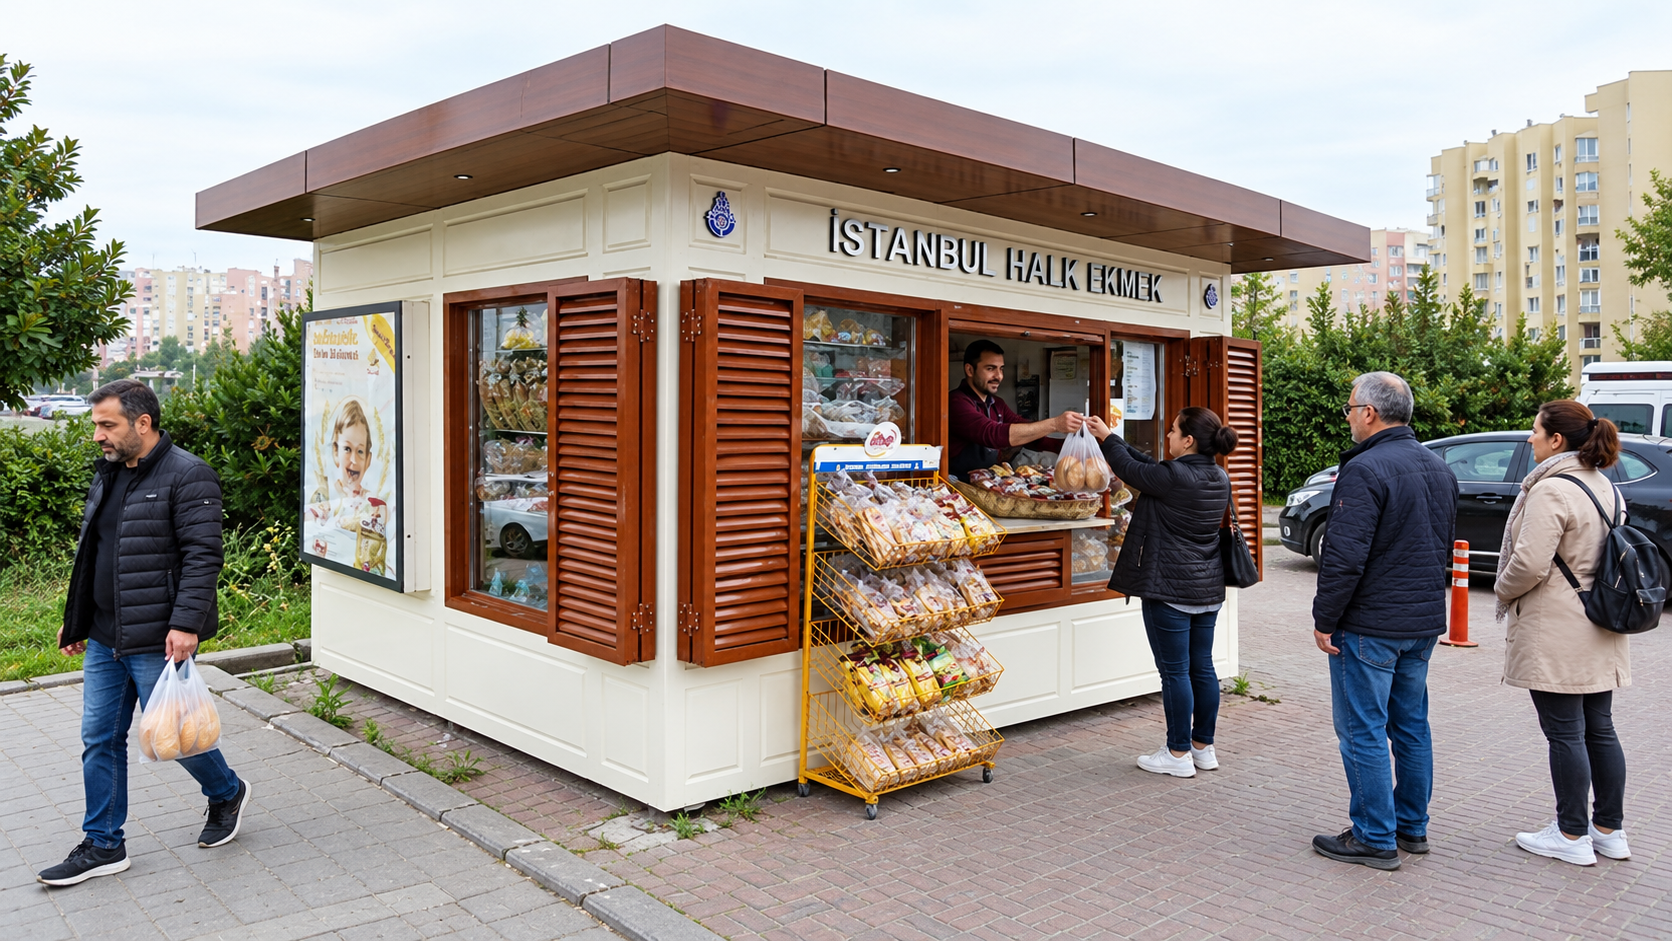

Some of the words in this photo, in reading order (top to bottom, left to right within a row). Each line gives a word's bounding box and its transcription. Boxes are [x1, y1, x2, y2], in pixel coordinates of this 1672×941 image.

[829, 208, 997, 277] İSTANBUL
[1006, 247, 1080, 290] HALK
[1087, 262, 1163, 302] EKMEK
